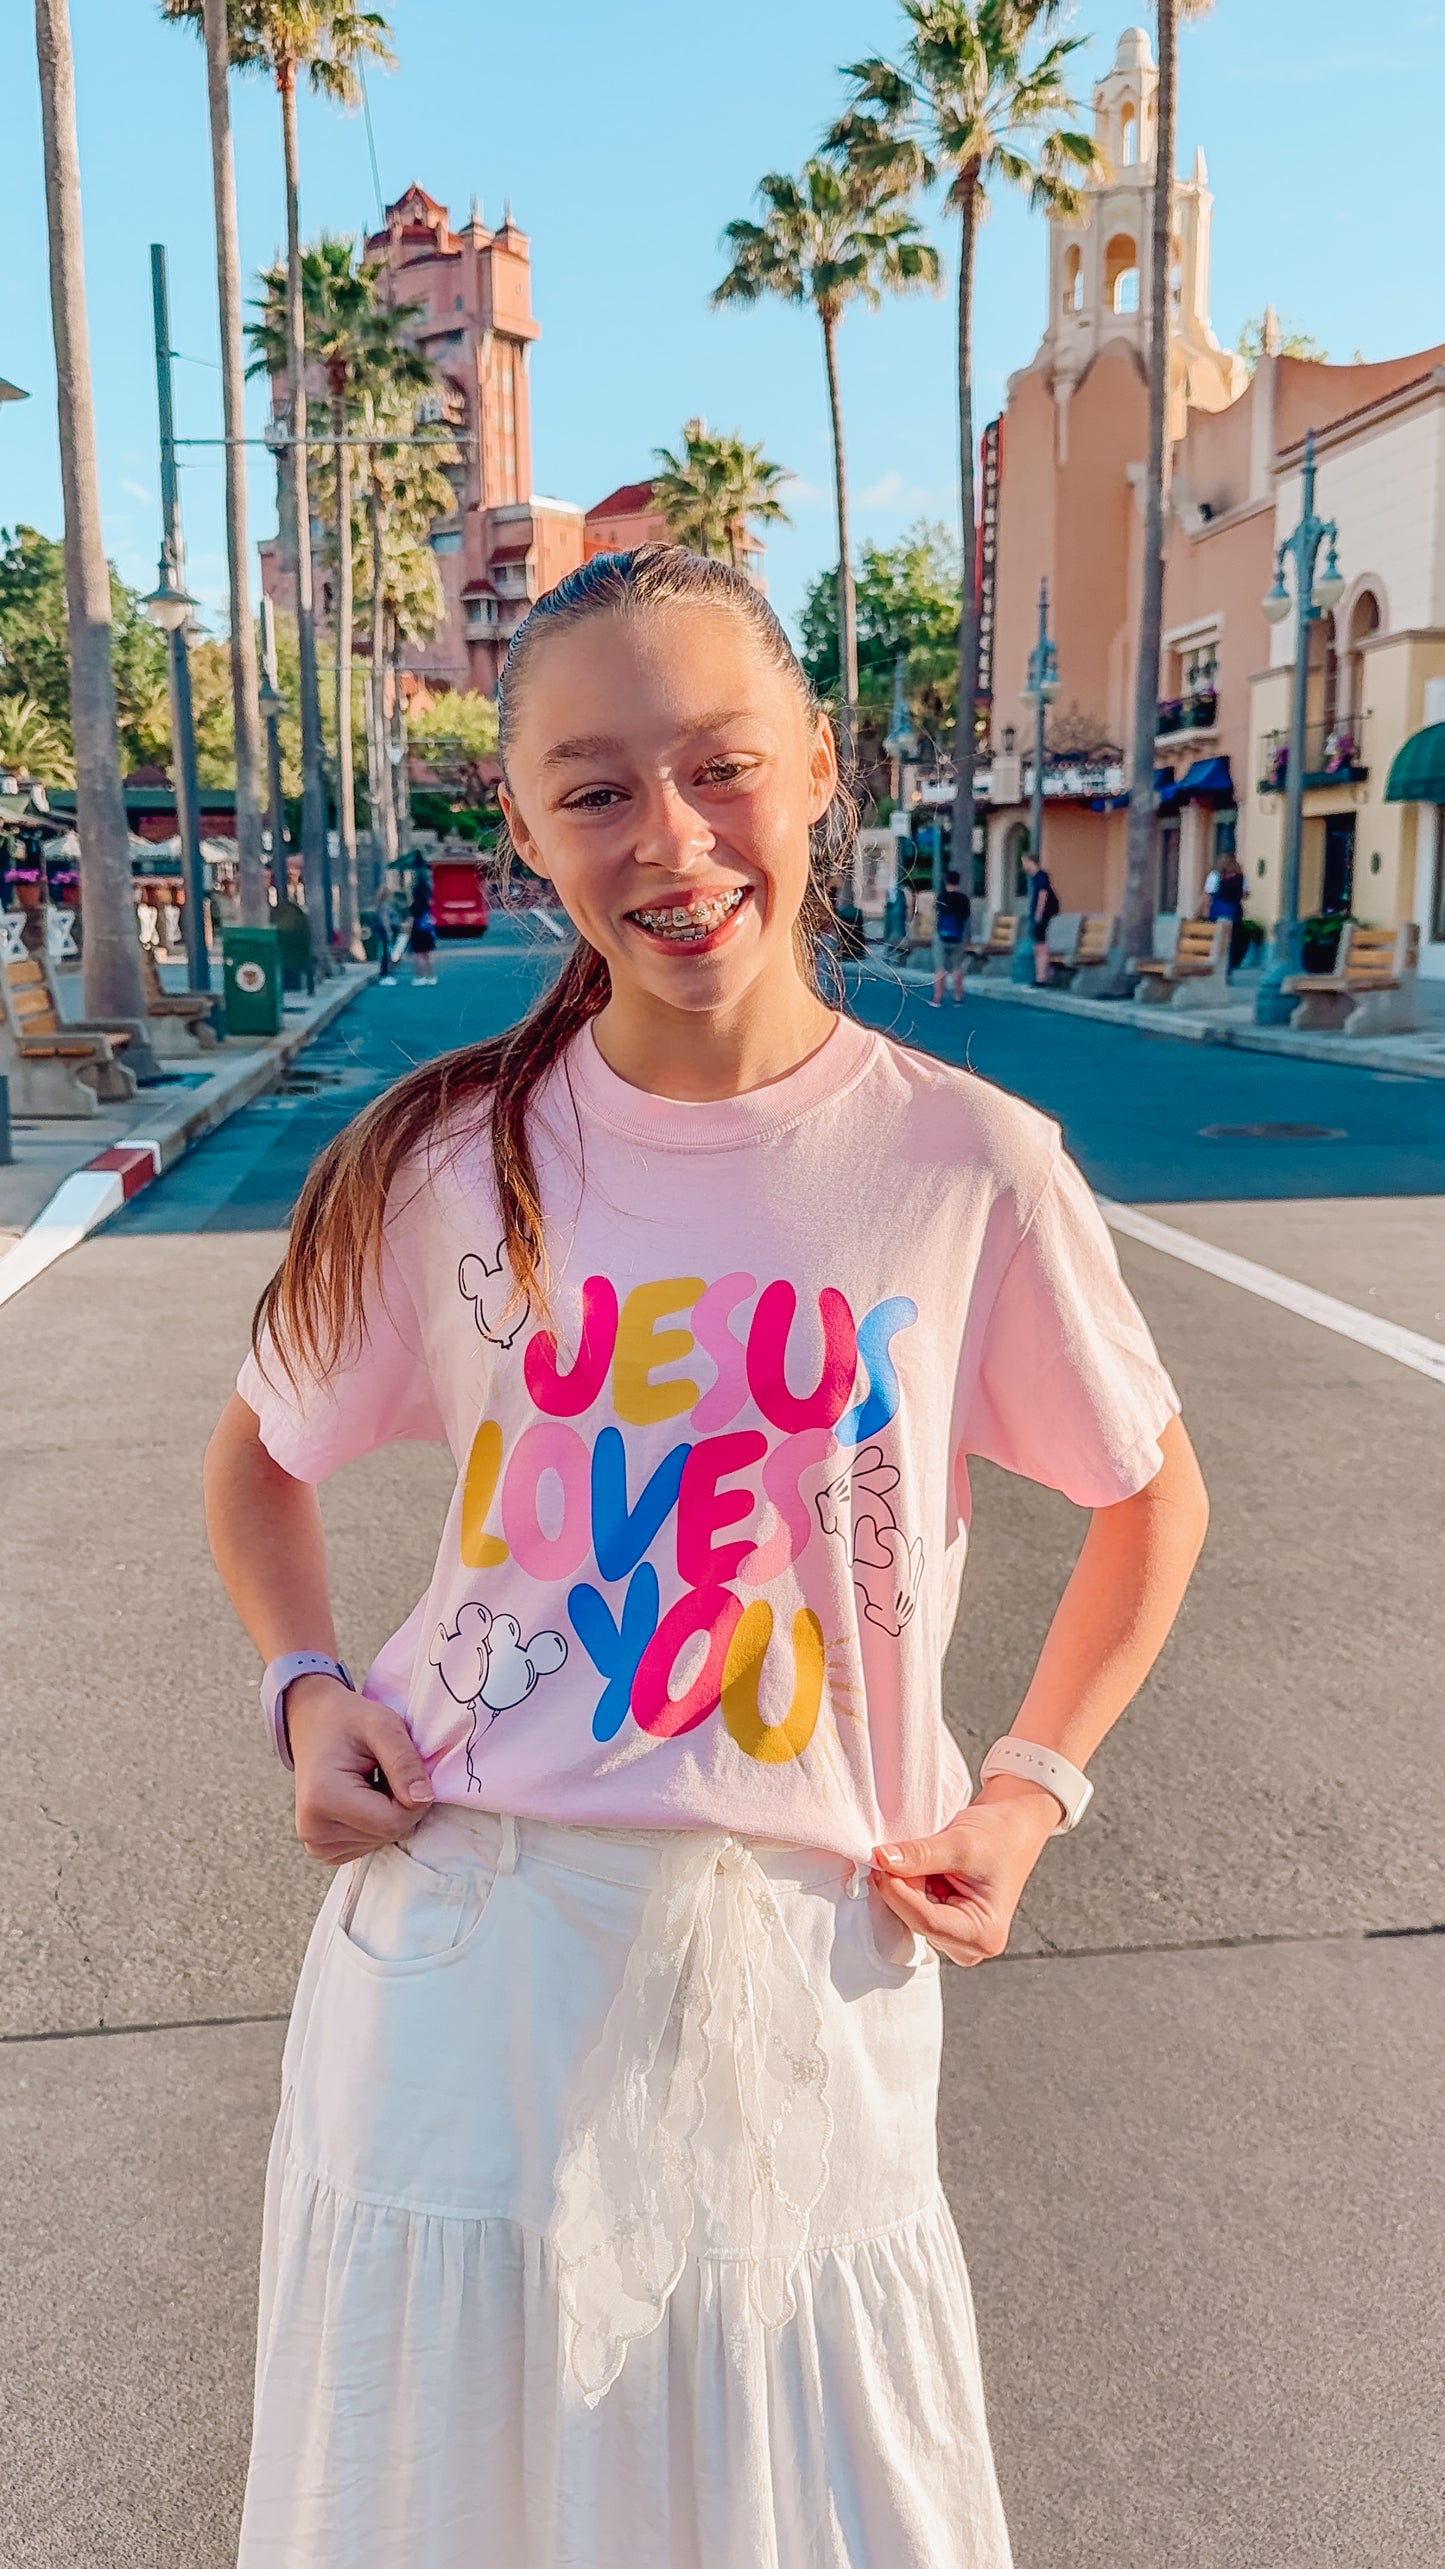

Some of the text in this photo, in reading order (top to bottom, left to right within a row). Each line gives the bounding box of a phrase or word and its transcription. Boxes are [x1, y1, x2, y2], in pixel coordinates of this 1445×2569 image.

[524, 1272, 919, 1447] JESUS
[461, 1420, 838, 1588] LOVES
[568, 1562, 825, 1764] YOU
